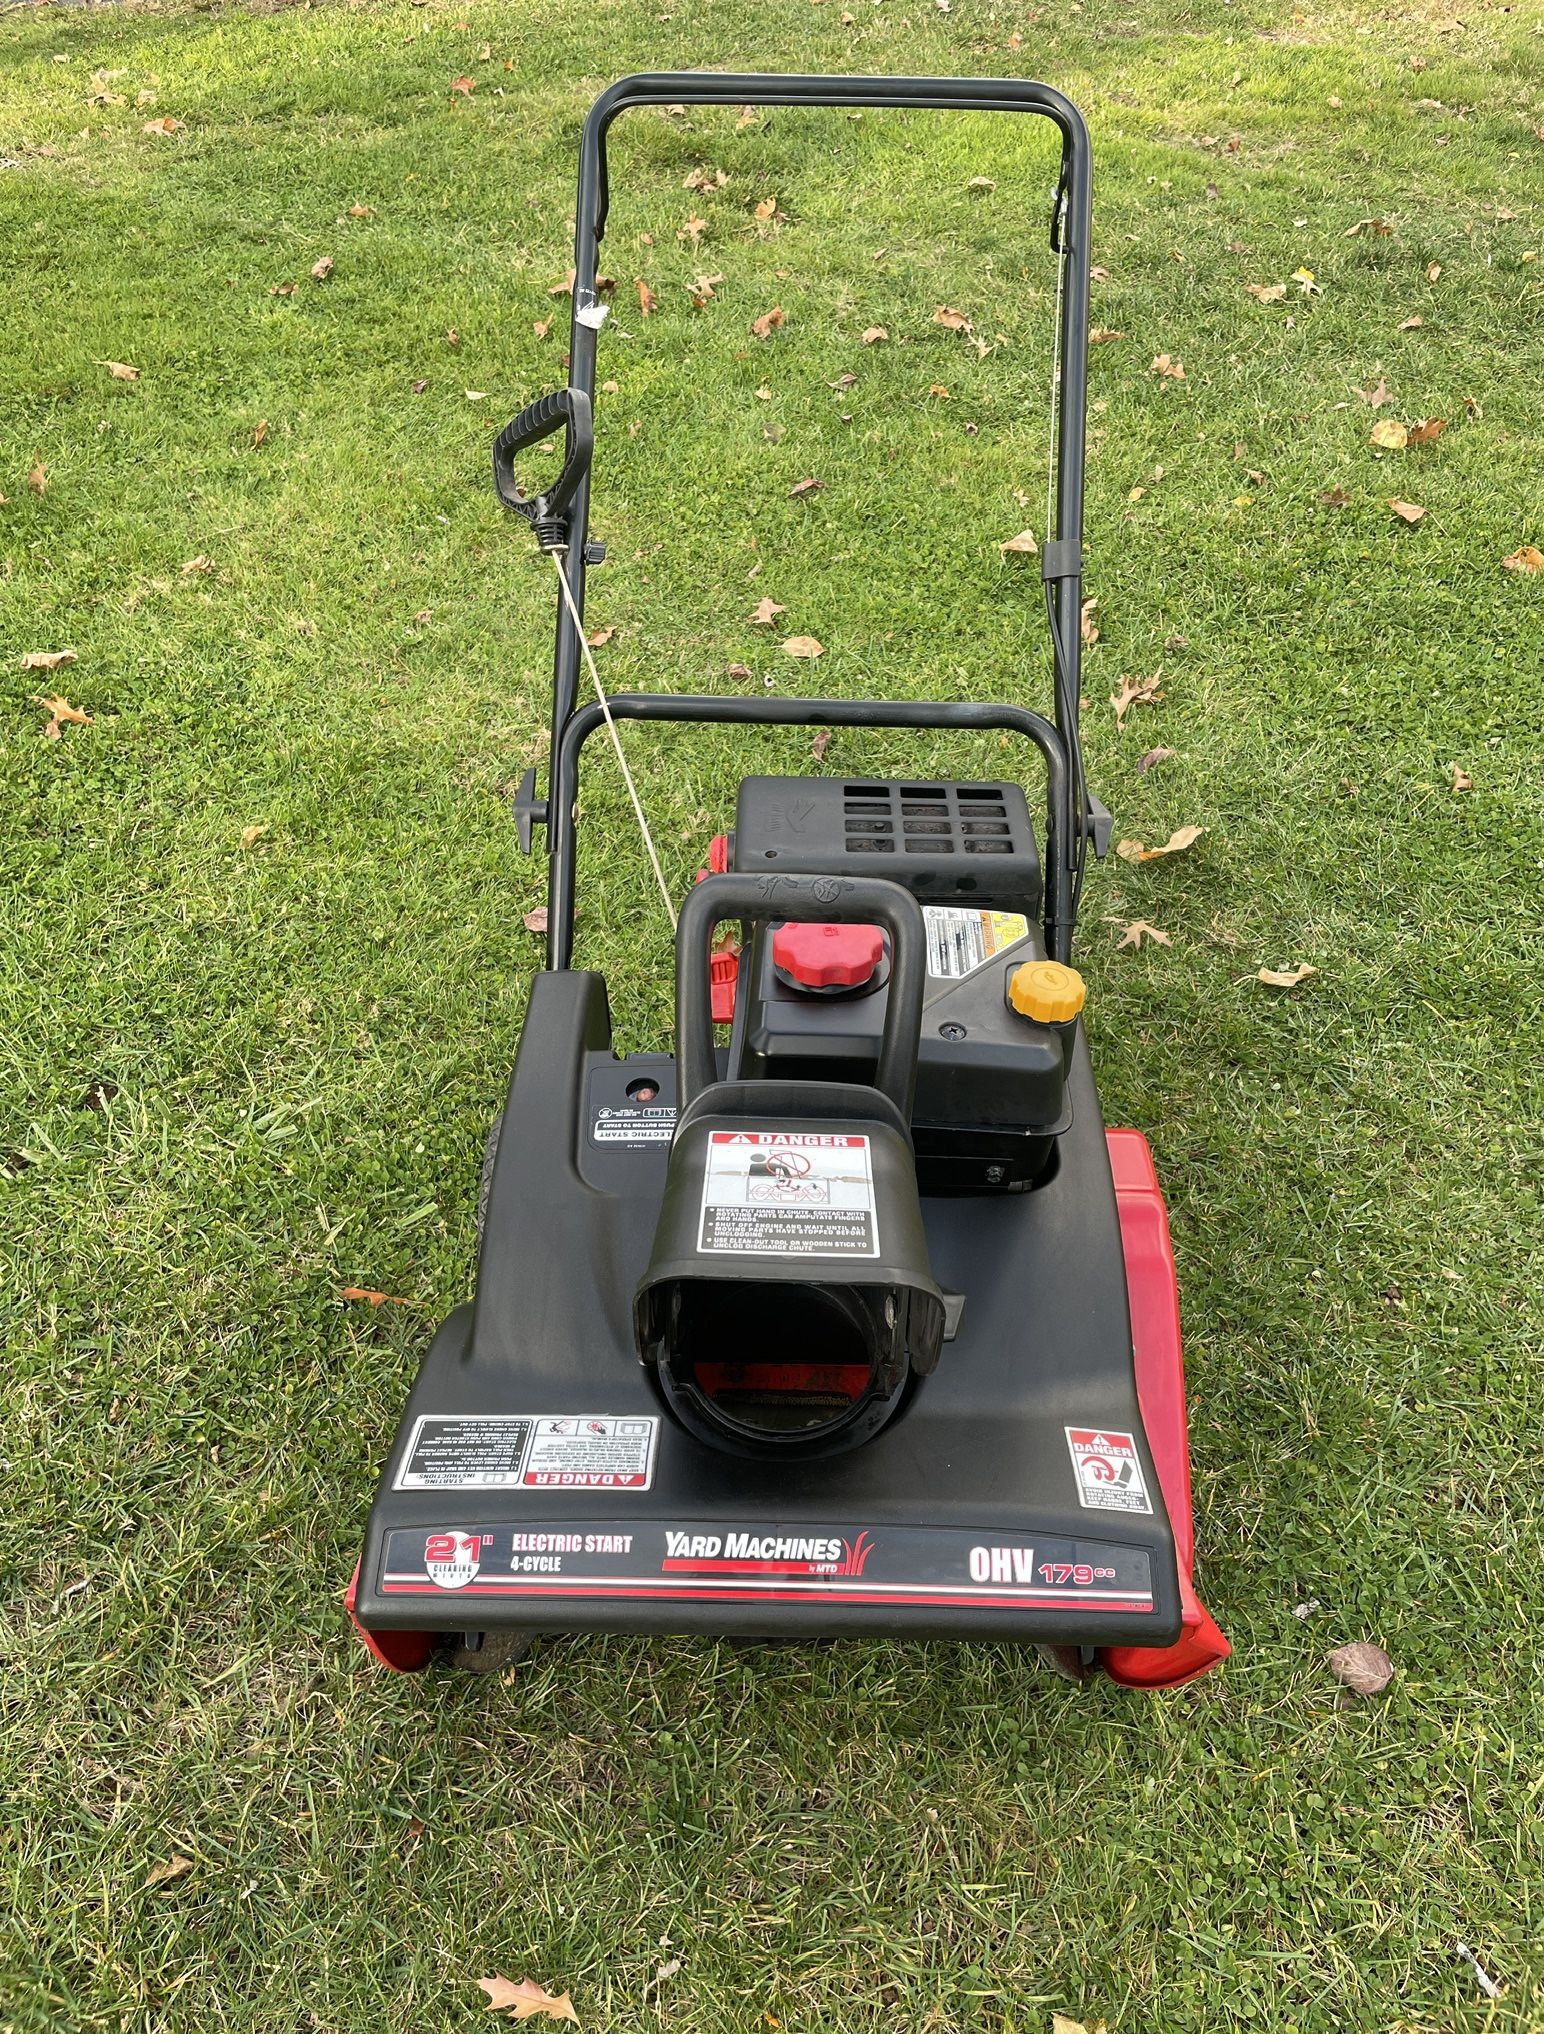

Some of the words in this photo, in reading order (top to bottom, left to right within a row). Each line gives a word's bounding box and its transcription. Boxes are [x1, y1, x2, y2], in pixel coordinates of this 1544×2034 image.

[758, 1135, 848, 1146] DANGER
[1074, 1442, 1133, 1457] DANGER
[536, 1474, 614, 1484] DANGER
[424, 1534, 494, 1563] 21"
[512, 1534, 582, 1552] ELECTRIC
[584, 1535, 633, 1553] START
[665, 1532, 722, 1558] YARD
[724, 1532, 842, 1560] MACHINES
[433, 1564, 472, 1572] CLEARING
[510, 1556, 562, 1572] 4-CYCLE
[816, 1564, 838, 1573] MTD
[970, 1546, 1034, 1584] OHV
